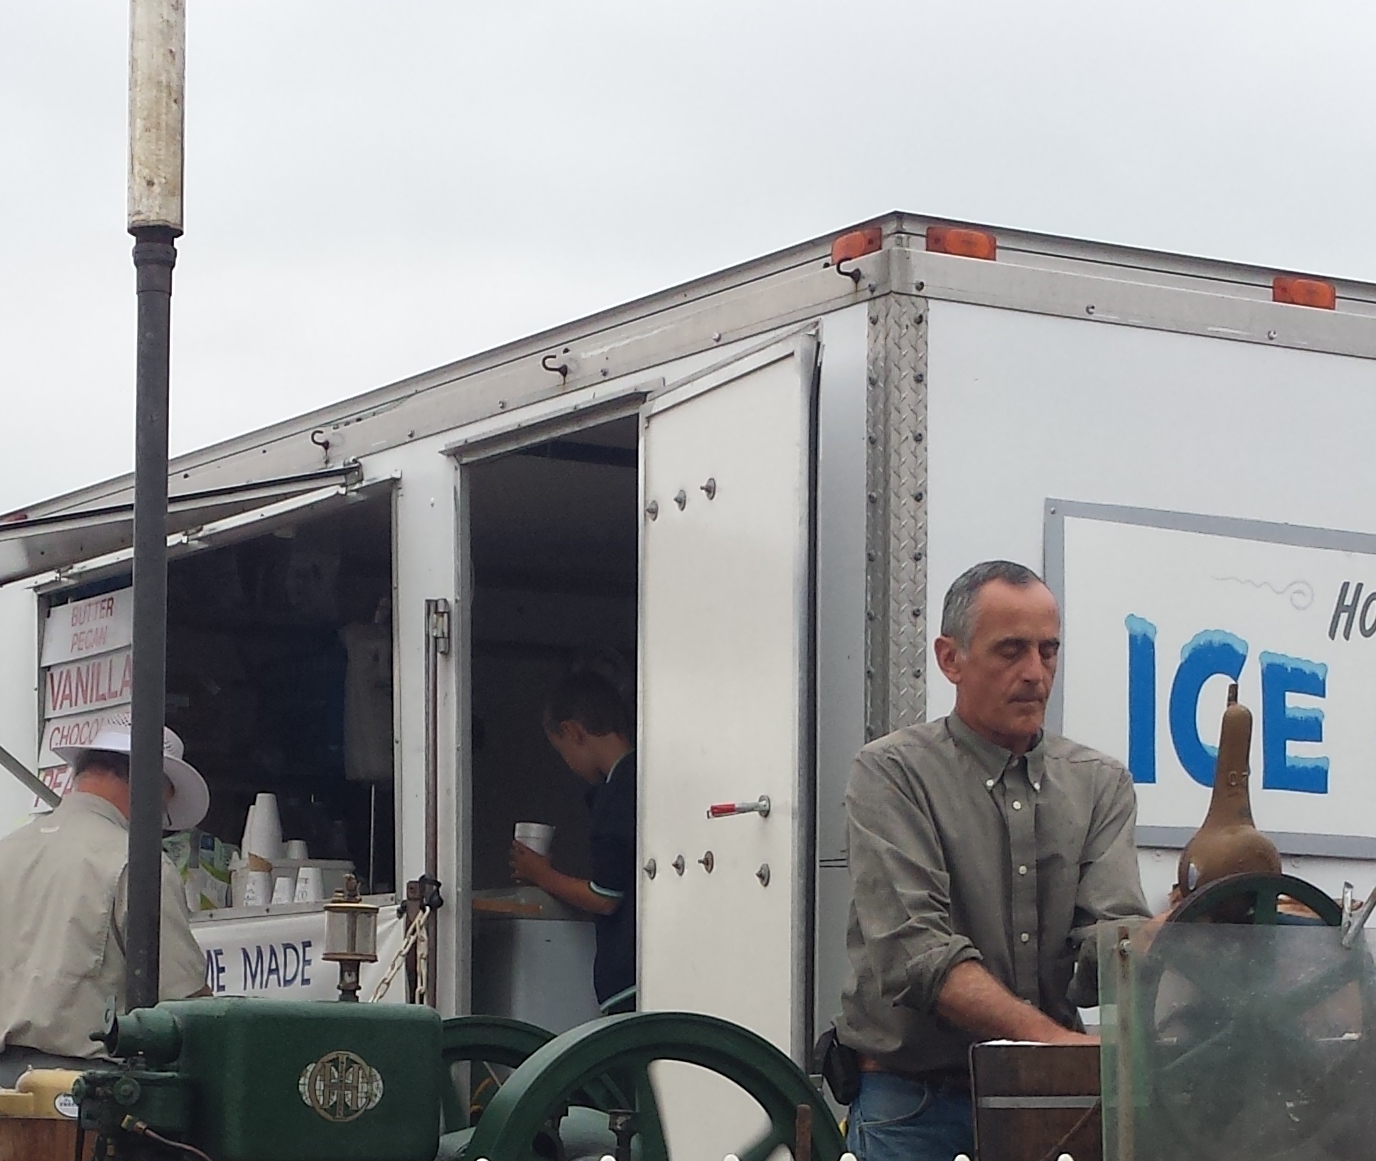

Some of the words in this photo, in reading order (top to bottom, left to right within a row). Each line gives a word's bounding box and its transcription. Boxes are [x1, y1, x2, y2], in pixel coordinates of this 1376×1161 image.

[71, 597, 114, 627] BUTTER
[49, 654, 132, 711] VANILLA
[1124, 613, 1329, 795] ICE
[50, 717, 105, 751] CHOCO
[241, 940, 312, 991] MADE
